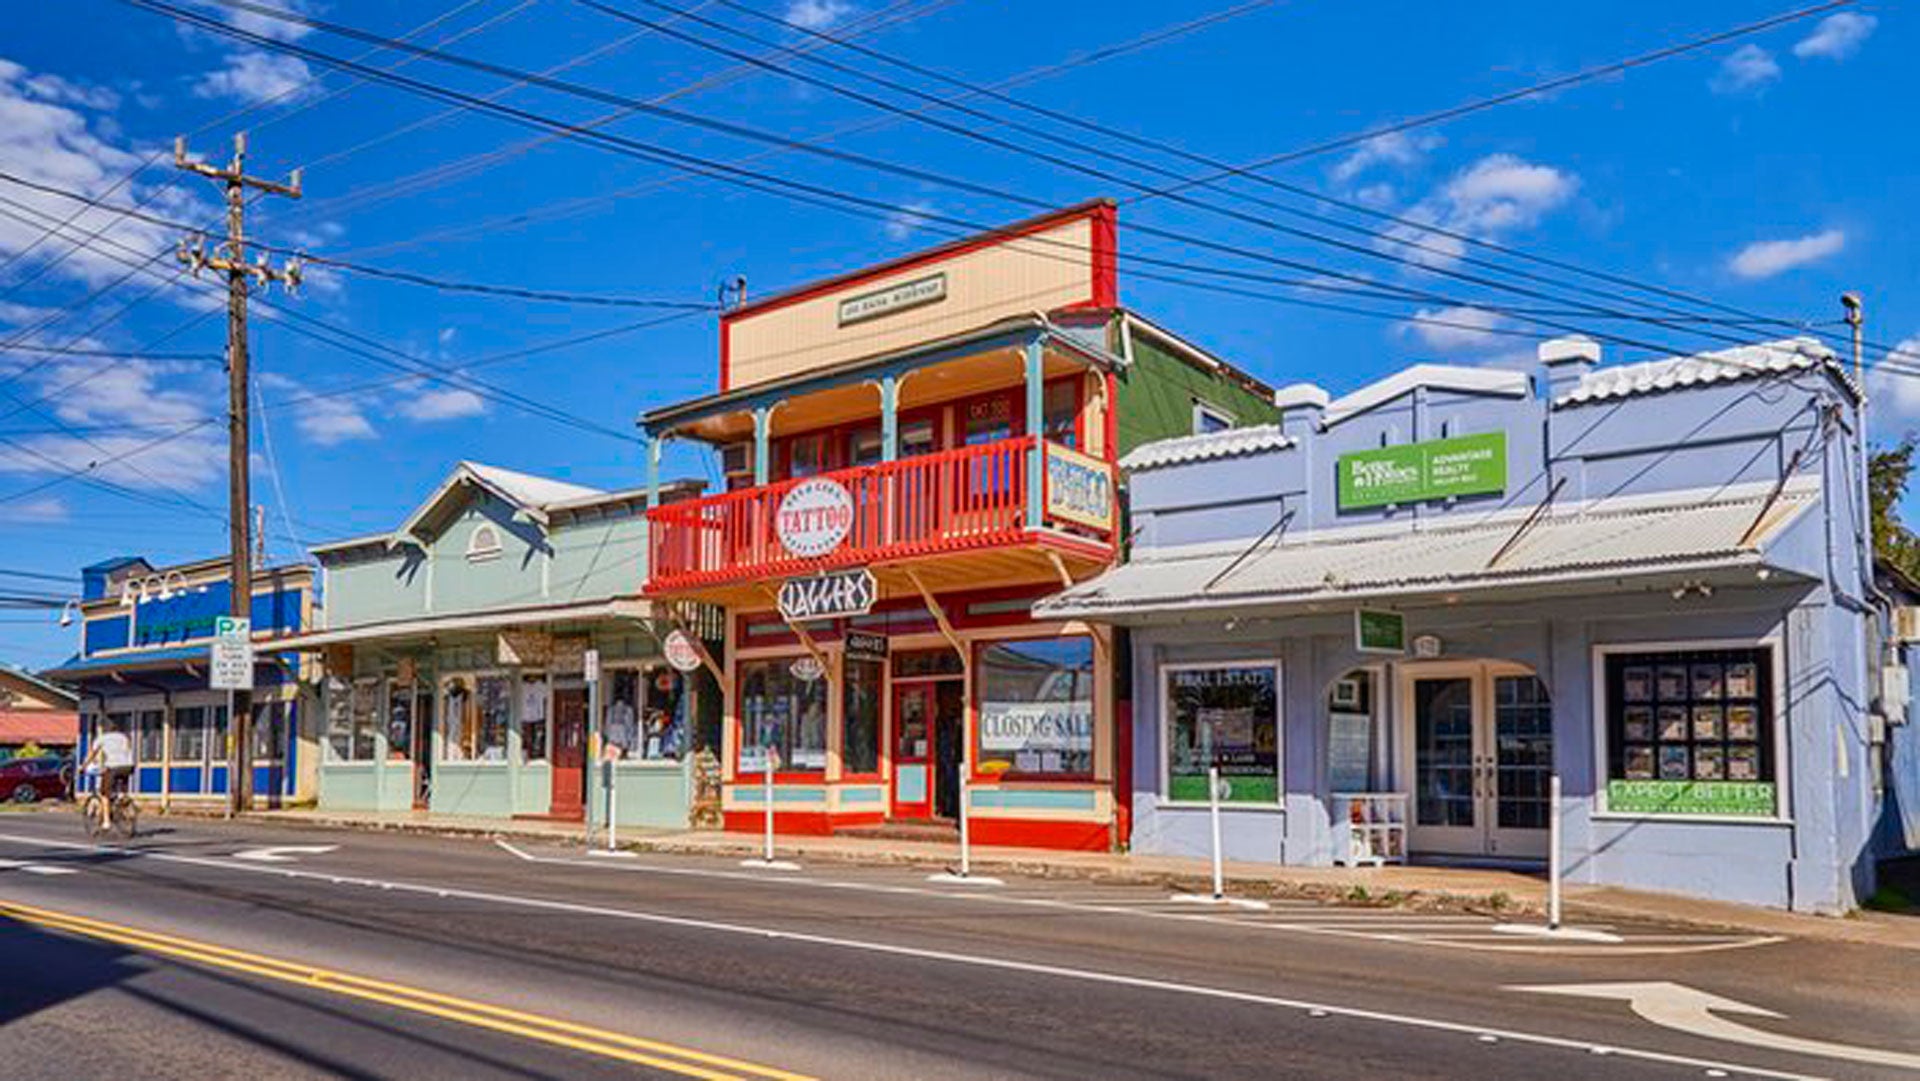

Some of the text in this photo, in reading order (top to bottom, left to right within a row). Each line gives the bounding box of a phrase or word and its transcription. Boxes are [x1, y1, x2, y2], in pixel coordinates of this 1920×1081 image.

[782, 505, 850, 534] TATTOO
[782, 573, 869, 616] JAGGERS
[983, 715, 1051, 738] CLOSING
[1610, 781, 1772, 801] EXPECT BETTER
